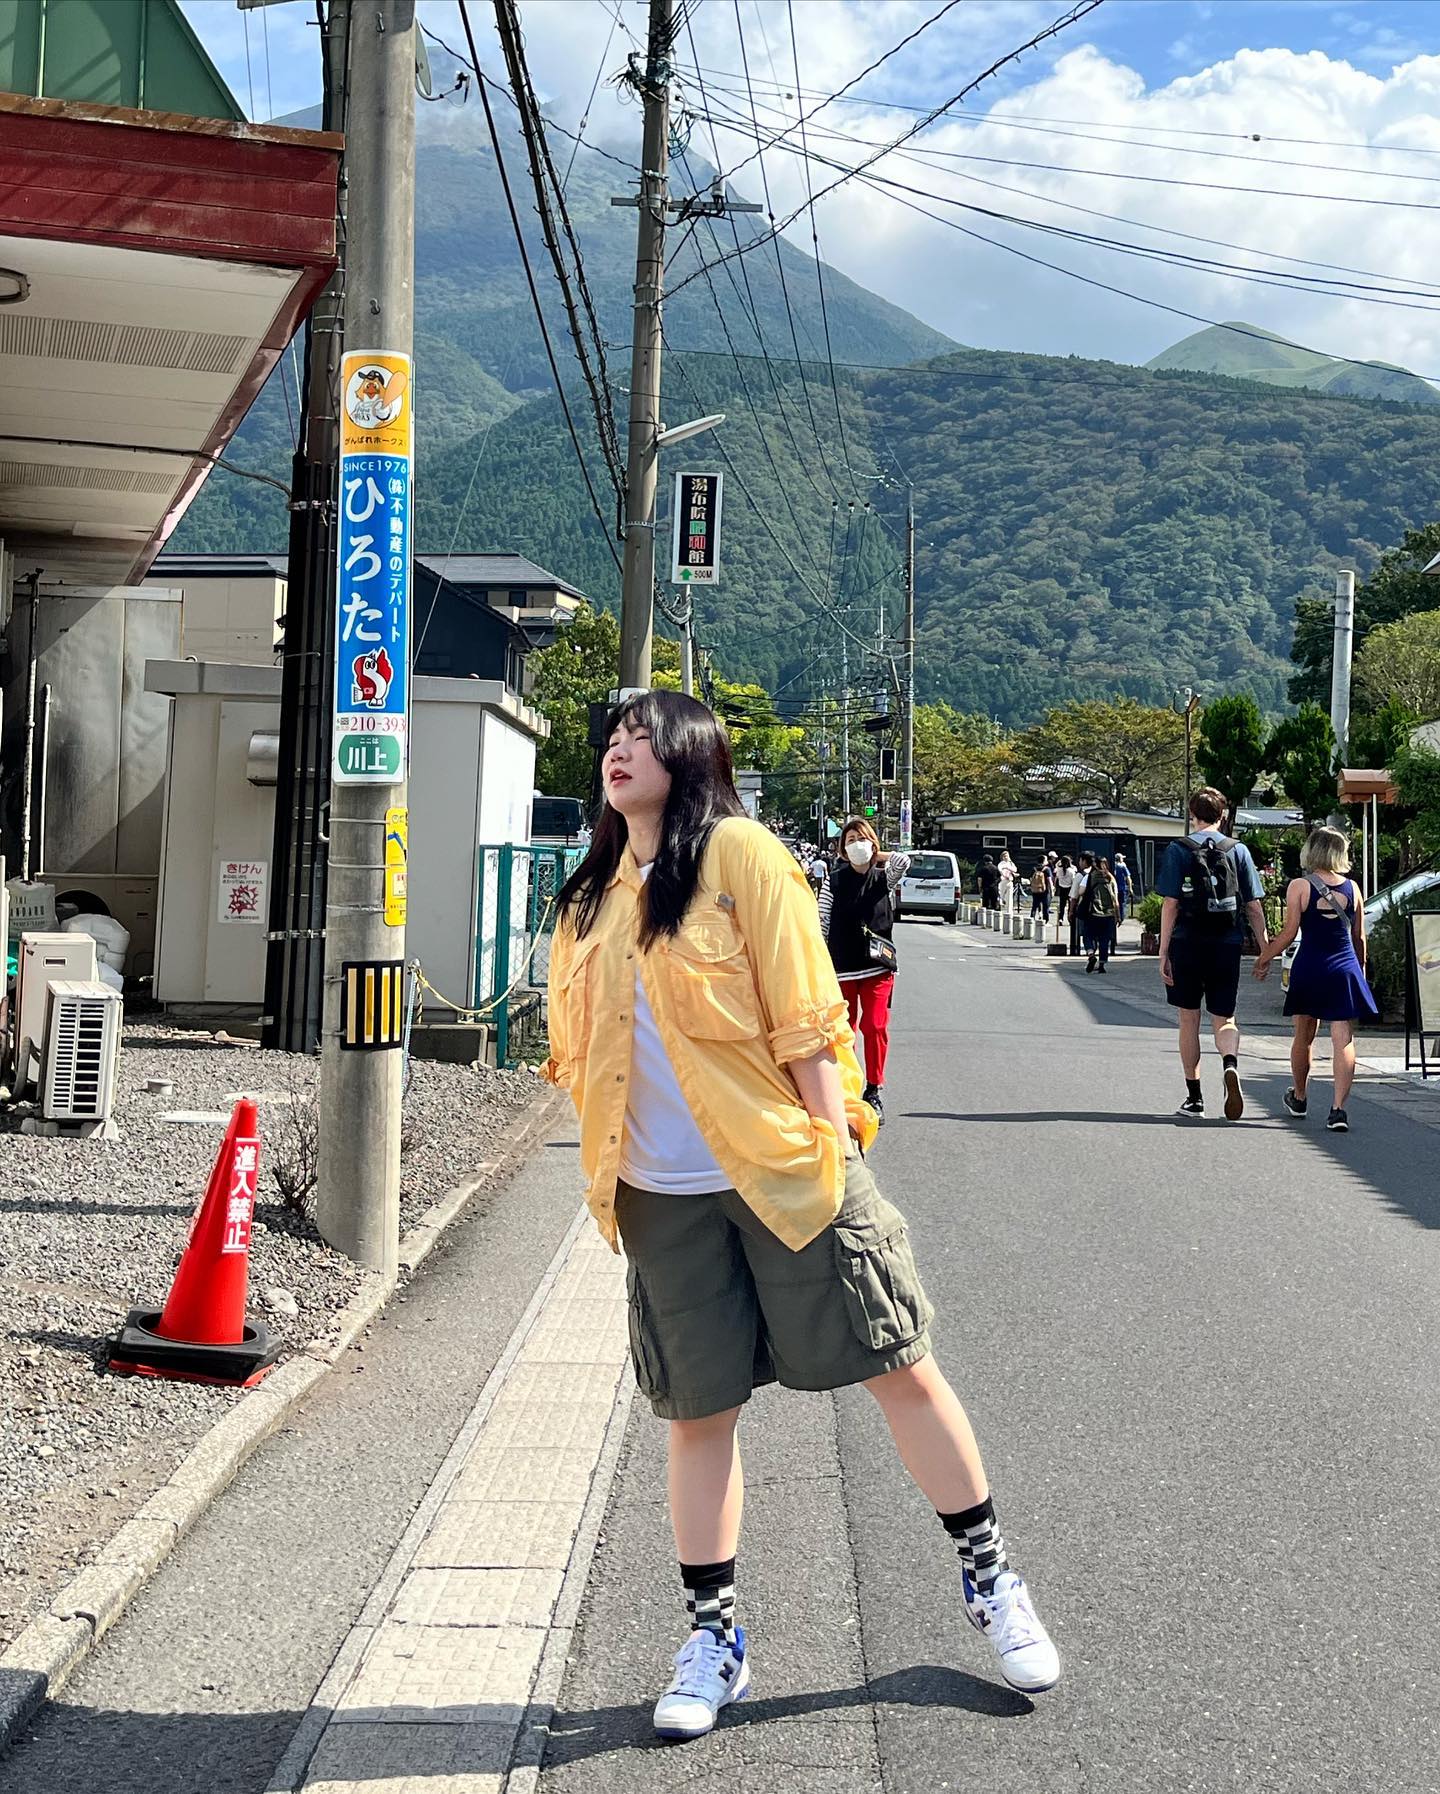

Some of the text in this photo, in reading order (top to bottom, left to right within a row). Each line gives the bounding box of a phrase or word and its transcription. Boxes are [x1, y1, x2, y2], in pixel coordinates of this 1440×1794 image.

[344, 459, 407, 474] SINCE 1976
[342, 476, 386, 643] ひろた
[694, 570, 713, 579] 500M
[347, 746, 388, 771] 川上
[226, 863, 263, 875] きけん
[223, 1145, 257, 1249] 進入禁止
